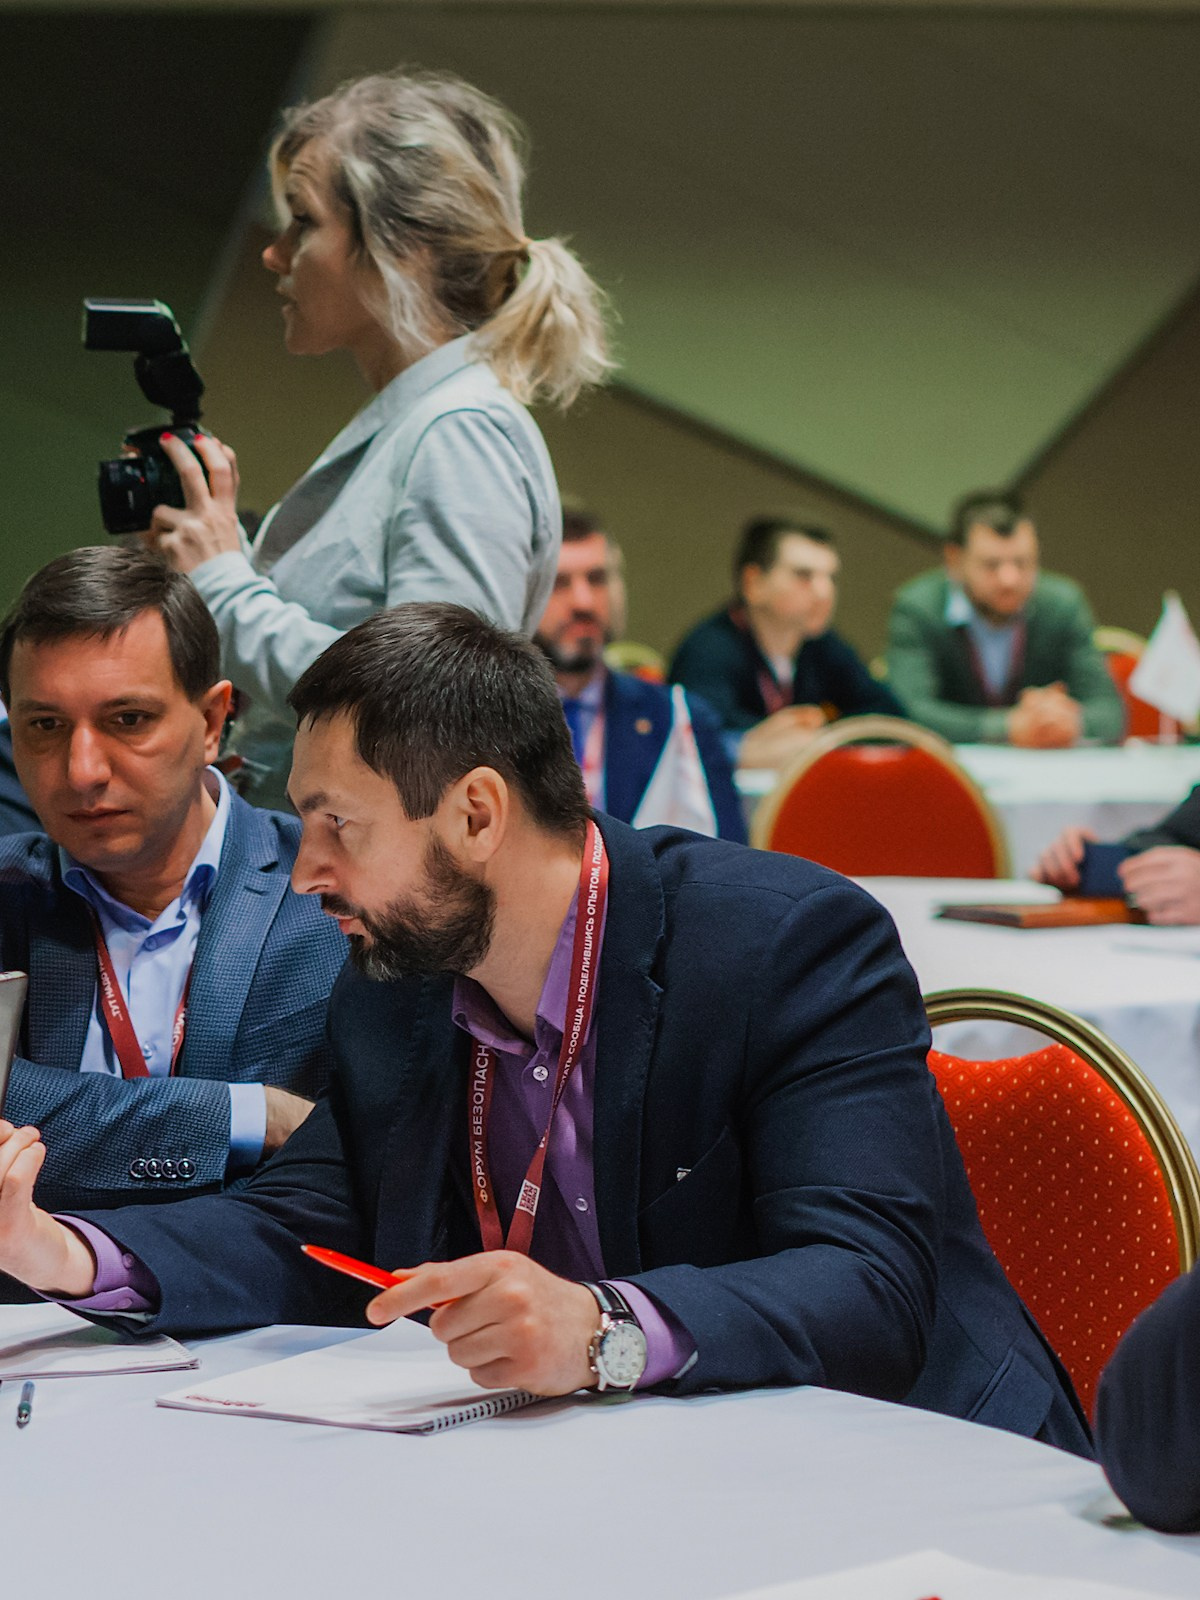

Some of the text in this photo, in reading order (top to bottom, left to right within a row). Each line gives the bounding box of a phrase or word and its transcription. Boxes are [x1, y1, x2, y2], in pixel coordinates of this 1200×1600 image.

[568, 1004, 585, 1054] СООБЩА:
[577, 917, 595, 1003] ПОДЕЛИВШИСЬ
[475, 1141, 490, 1203] ФОРУМ
